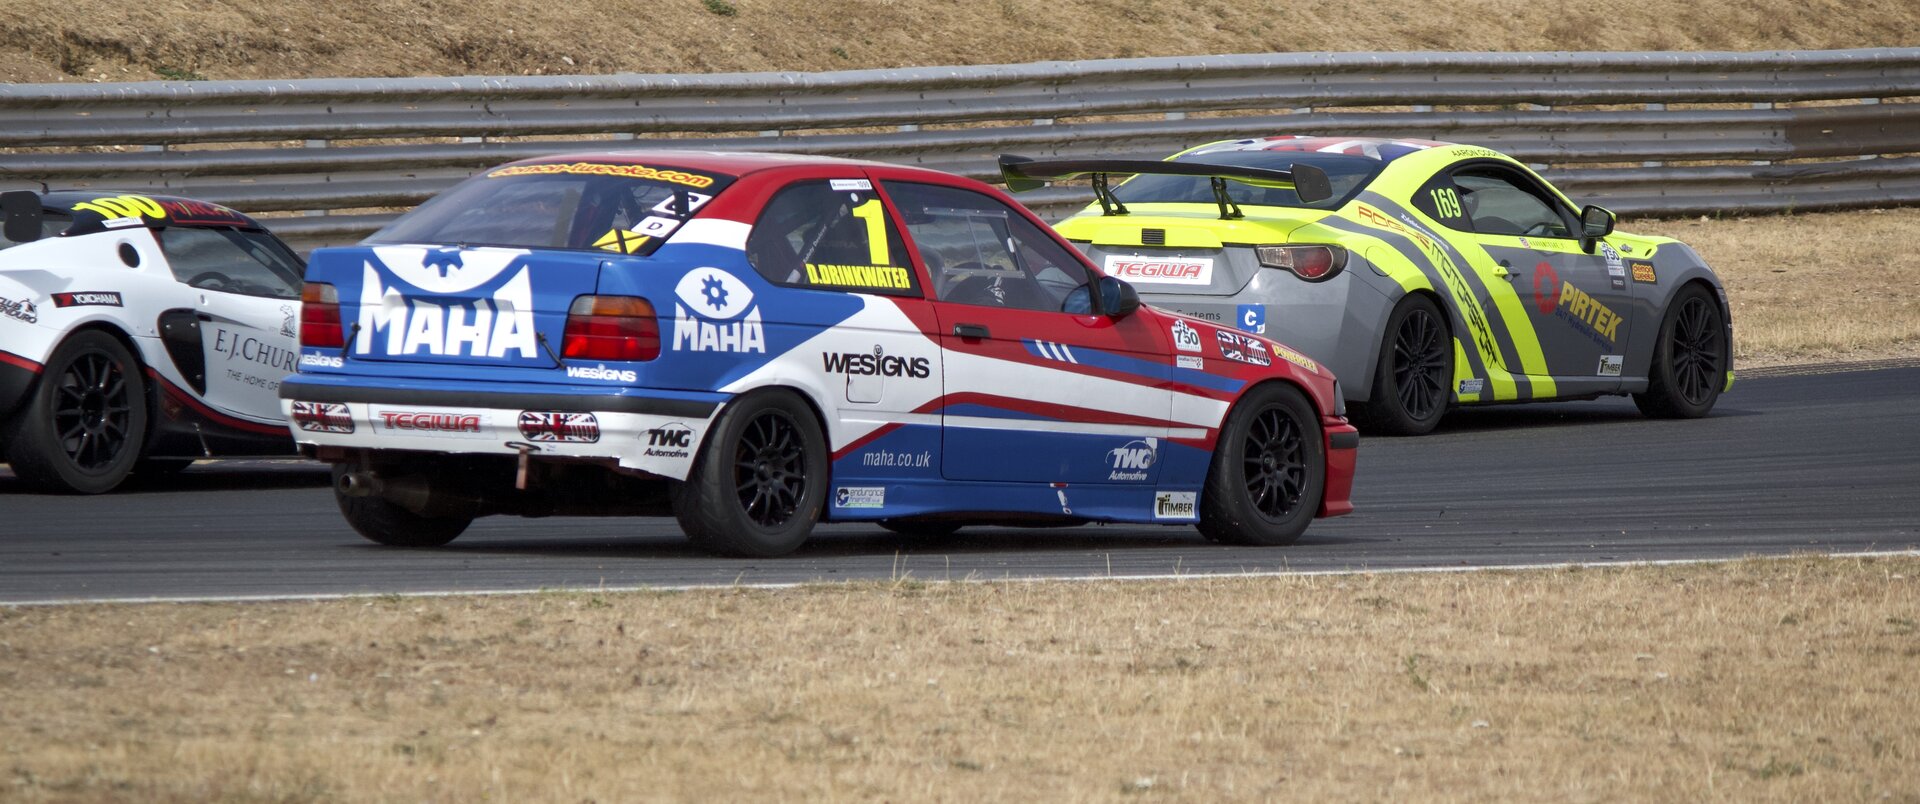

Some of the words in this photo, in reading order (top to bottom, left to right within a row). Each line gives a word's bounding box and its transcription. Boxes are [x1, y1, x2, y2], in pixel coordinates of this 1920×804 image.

[71, 194, 166, 219] 100
[1431, 188, 1462, 218] 169
[646, 222, 663, 230] D
[852, 199, 890, 265] 1
[805, 263, 911, 289] D.DRINKWATER
[1114, 261, 1204, 279] TEGIWA
[1358, 206, 1430, 250] ROGUE
[1432, 243, 1497, 369] MOTORSPORT
[72, 293, 120, 305] YOKOHAMA
[356, 259, 538, 358] MAHA
[1244, 310, 1258, 327] C
[1558, 281, 1624, 343] PIRTEK
[672, 302, 766, 353] MAHA
[1174, 330, 1199, 346] 750
[214, 328, 300, 373] E.J.CHUR
[227, 369, 241, 381] THE
[243, 374, 266, 388] HOME
[379, 411, 482, 433] TEGIWA
[648, 428, 691, 448] TWG
[644, 448, 689, 458] Automotive
[863, 449, 932, 467] maha.co.uk
[1108, 470, 1147, 480] Automotive
[1164, 502, 1193, 513] TIMBER
